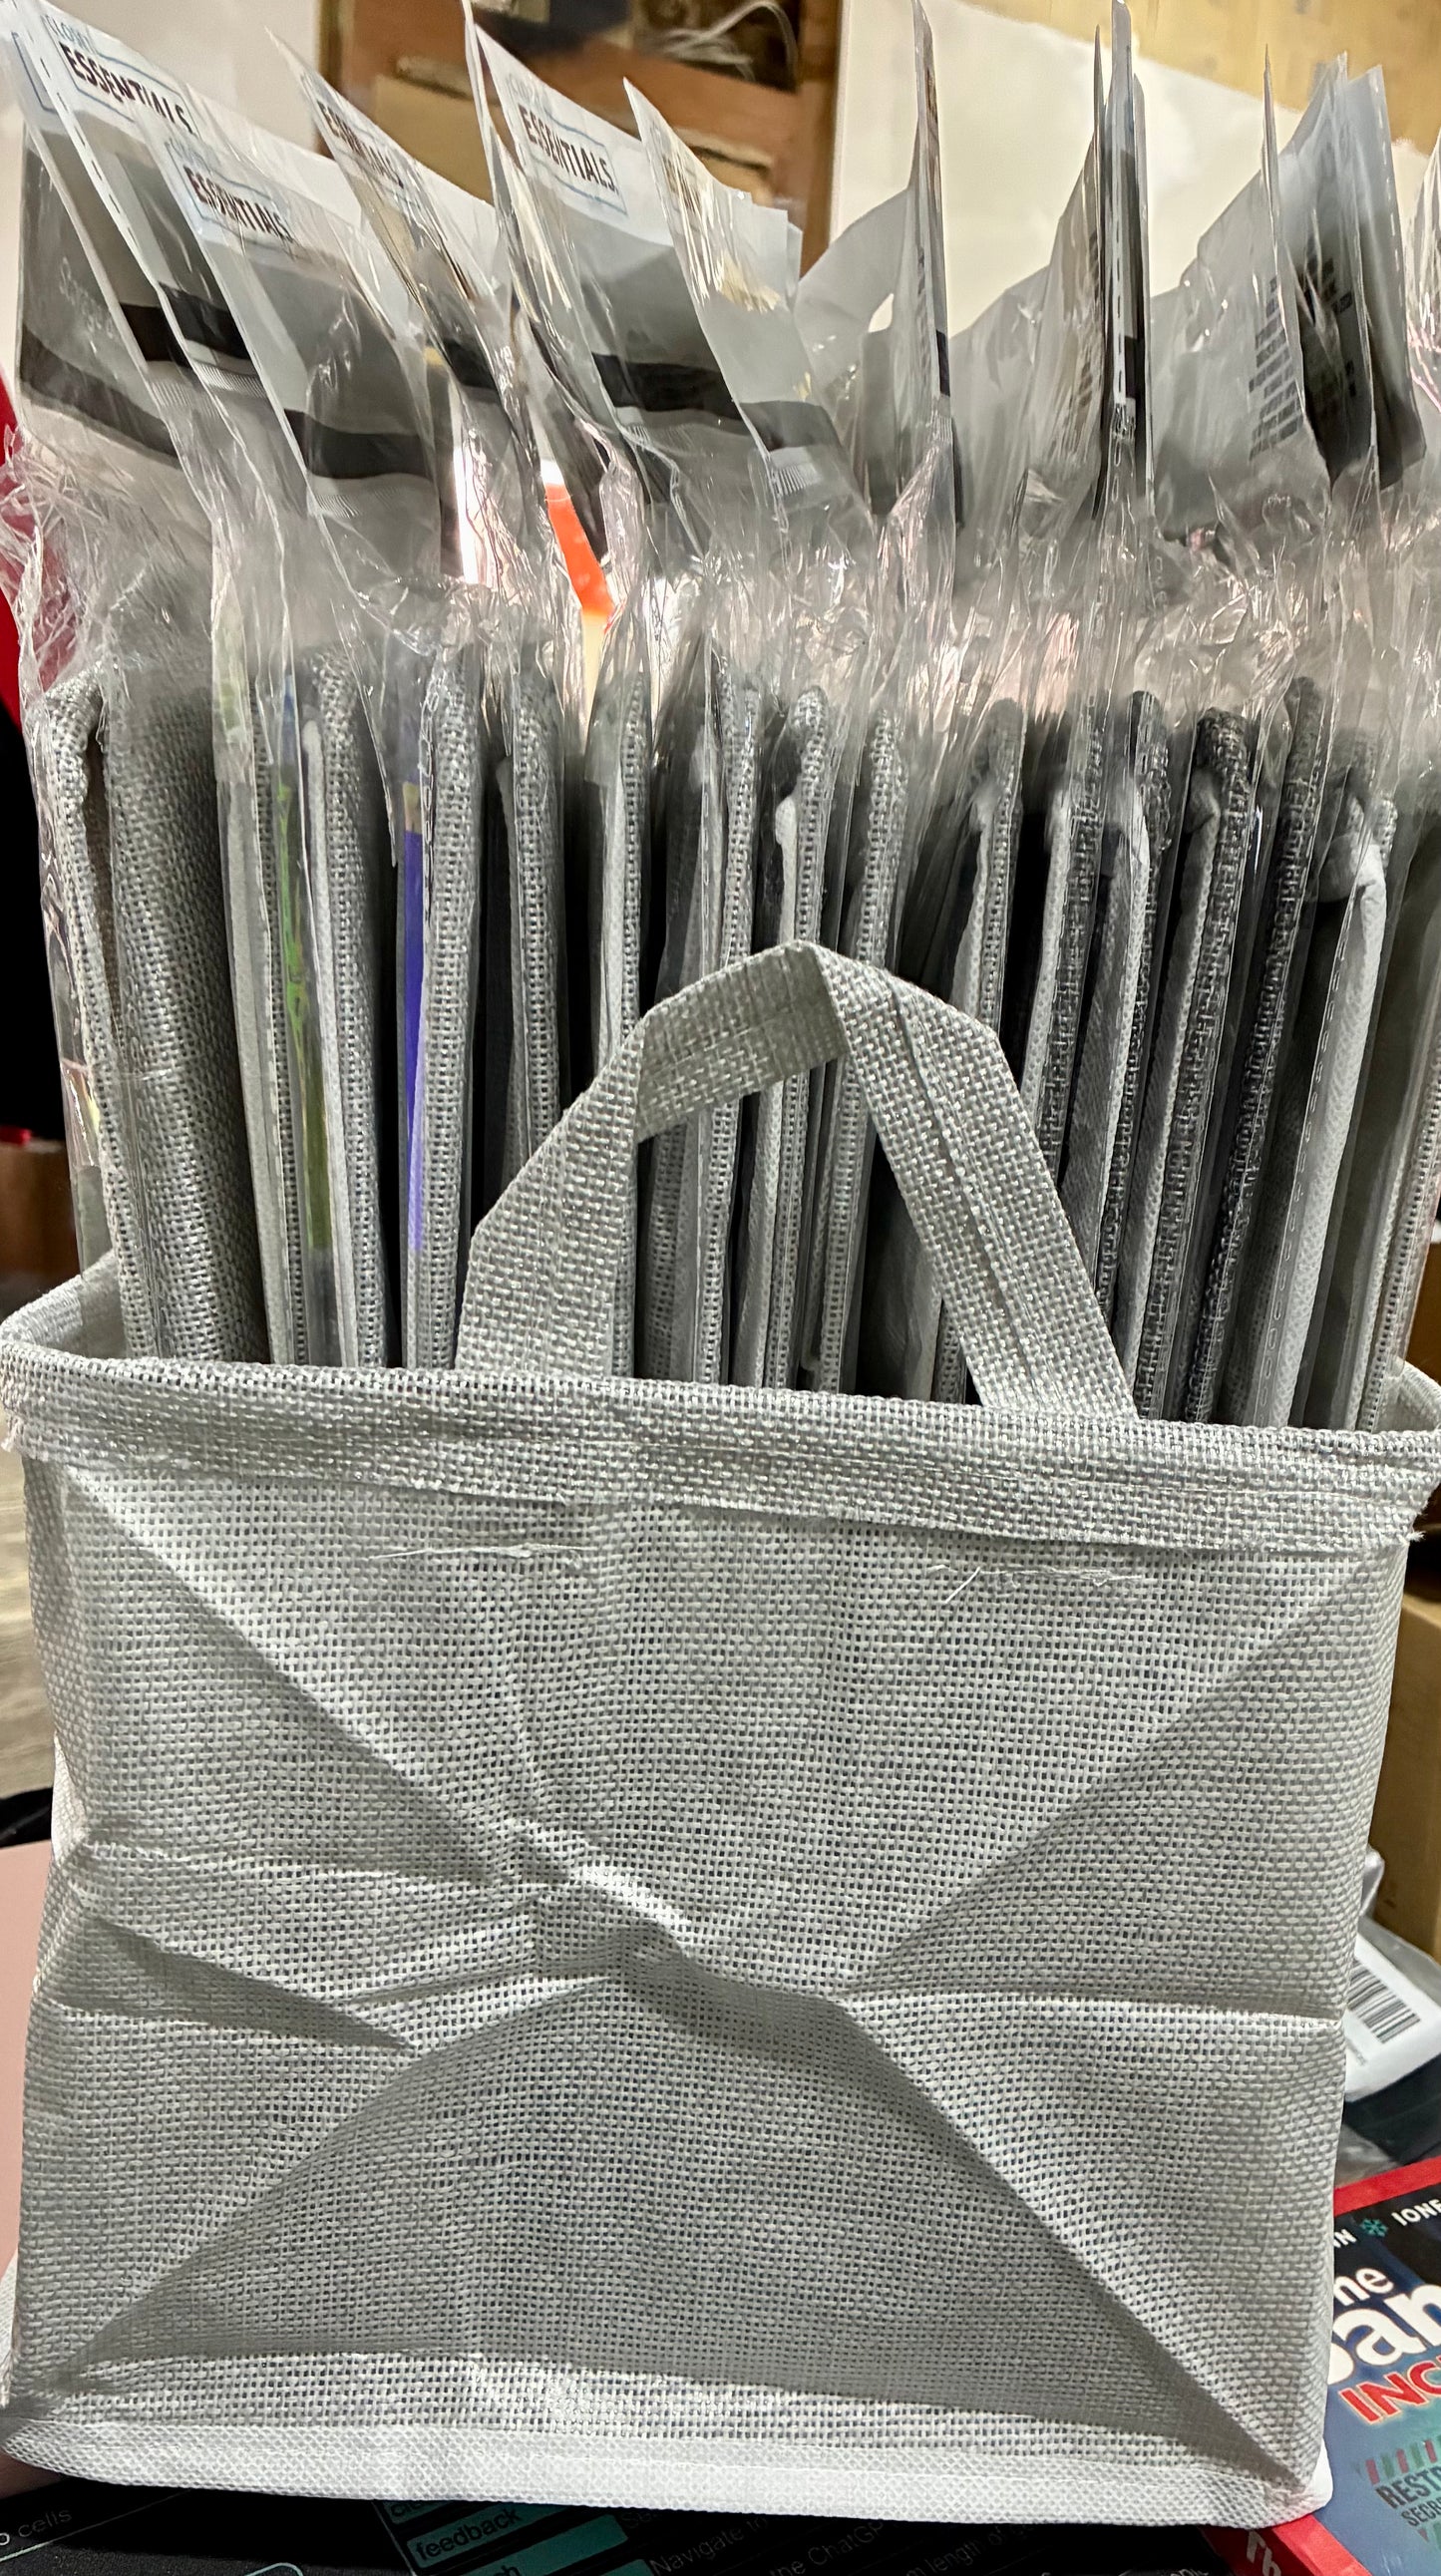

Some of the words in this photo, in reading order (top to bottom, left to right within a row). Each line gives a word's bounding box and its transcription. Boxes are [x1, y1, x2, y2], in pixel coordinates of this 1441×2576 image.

[59, 41, 193, 135] ESSENTIALS
[316, 100, 404, 189] ESSEIALS
[518, 103, 615, 193] ESSENTIALS
[183, 165, 293, 243] ESSENTIALS
[1338, 2355, 1441, 2425] INC
[18, 2507, 73, 2538] cells
[416, 2507, 521, 2560] feedback
[649, 2527, 745, 2576] Navigate
[808, 2522, 885, 2565] ChatGP
